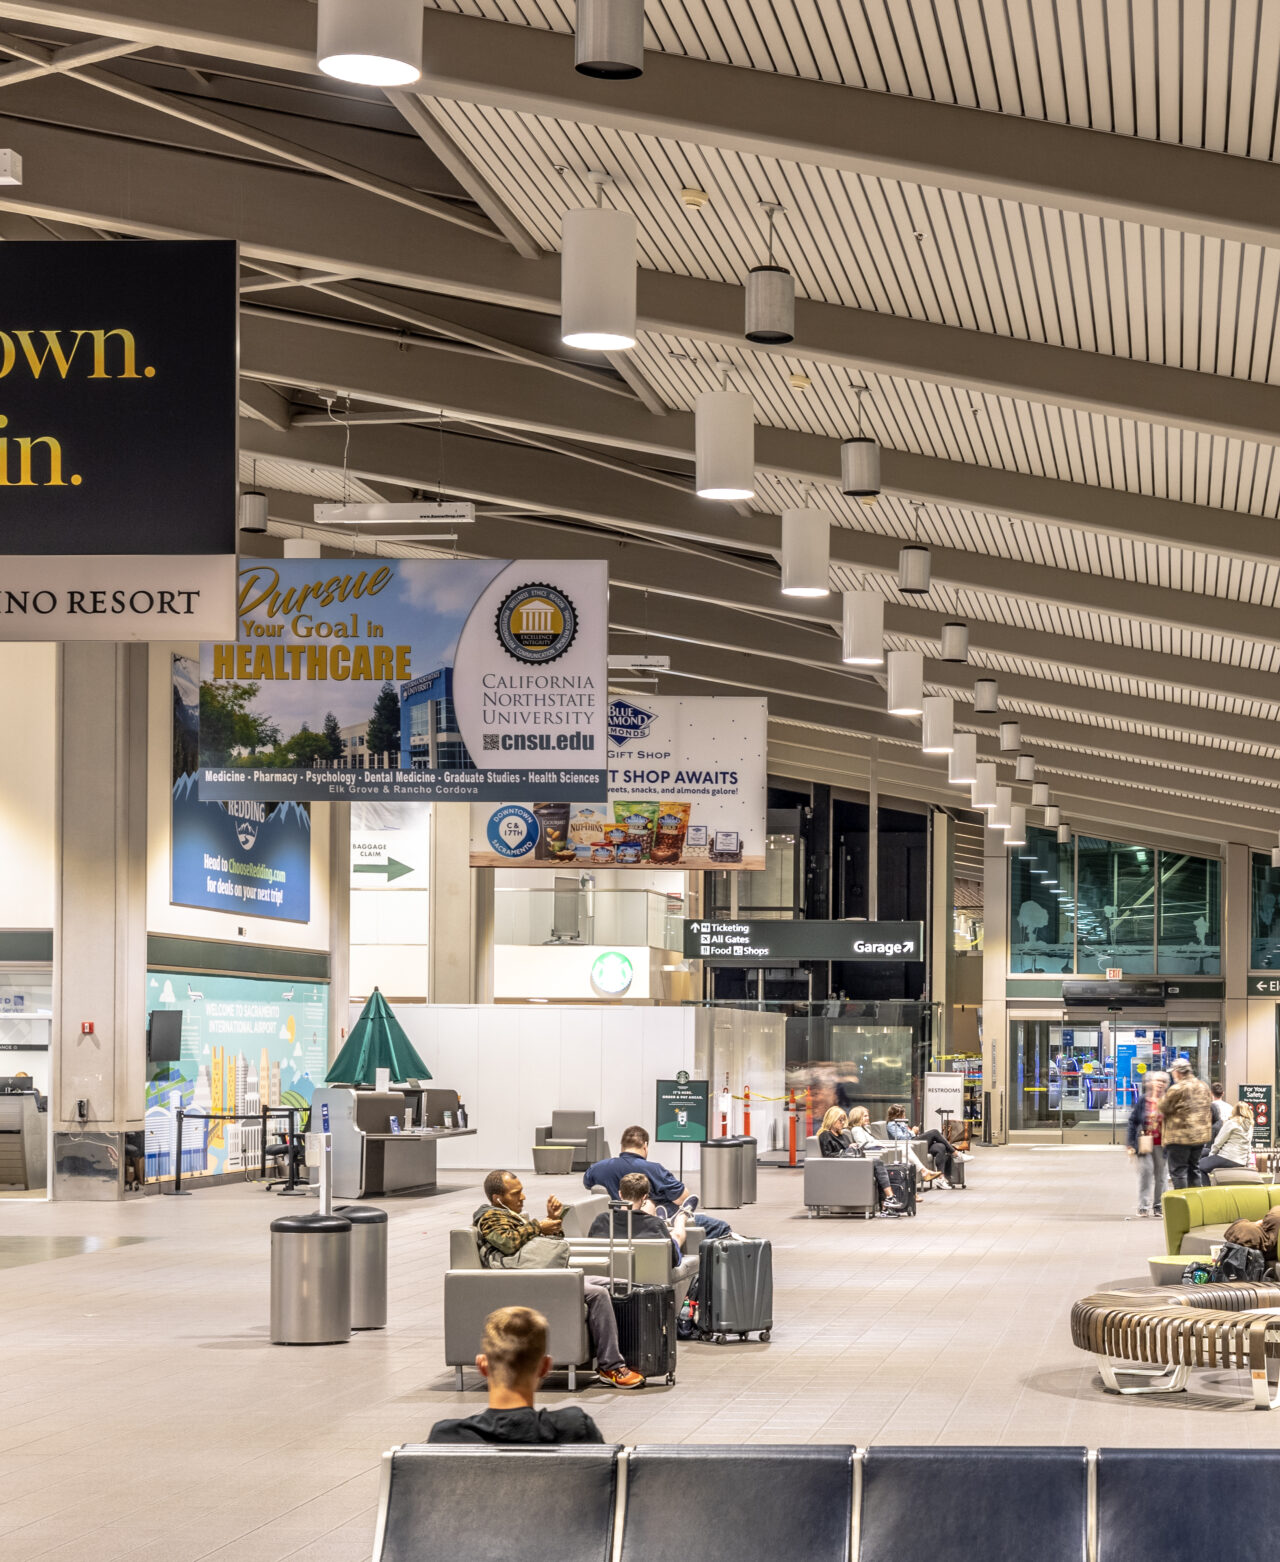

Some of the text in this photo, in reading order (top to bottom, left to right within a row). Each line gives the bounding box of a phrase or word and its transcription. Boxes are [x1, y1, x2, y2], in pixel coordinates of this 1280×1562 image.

[239, 565, 395, 618] Pursue
[0, 590, 200, 614] NO RESORT
[242, 613, 384, 639] Your Goal in
[213, 644, 412, 681] HEALTHCARE
[482, 673, 595, 689] CALIFORNIA
[482, 692, 596, 707] NORTHSTATE
[482, 709, 595, 725] UNIVERSITY
[608, 705, 635, 717] BLUE
[501, 731, 595, 751] cnsu.edu
[608, 750, 671, 759] GIFT SHOP
[205, 770, 246, 782] Medicine
[253, 771, 298, 785] Pharmacy
[306, 771, 356, 785] Psychology
[364, 771, 393, 783] Dental
[395, 772, 436, 783] Medicine
[444, 772, 485, 783] Graduate
[487, 772, 521, 783] Studies
[528, 772, 557, 783] Health
[559, 772, 600, 784] Sciences
[623, 770, 671, 783] SHOP
[674, 771, 738, 785] AWAITS
[329, 785, 479, 794] Elk Grove & Rancho Cordova
[631, 786, 659, 795] snacks,
[660, 786, 675, 794] and
[676, 786, 710, 795] almonds
[711, 787, 739, 797] galore!
[228, 800, 265, 823] REDDING
[493, 808, 533, 824] DOWNTOWN
[492, 839, 533, 855] SACRAMENTO
[203, 853, 286, 884] Head to ChooseRedding.com
[207, 875, 284, 907] for deals on your next trip!
[711, 923, 750, 934] Ticketing
[711, 934, 750, 944] All Gates
[711, 946, 769, 956] Food Shops
[853, 940, 903, 956] Garage
[1108, 969, 1121, 979] EXIT
[205, 1003, 280, 1018] WELCOME TO SACRAMENTO
[209, 1019, 277, 1033] INTERNATIONAL AIRPORT
